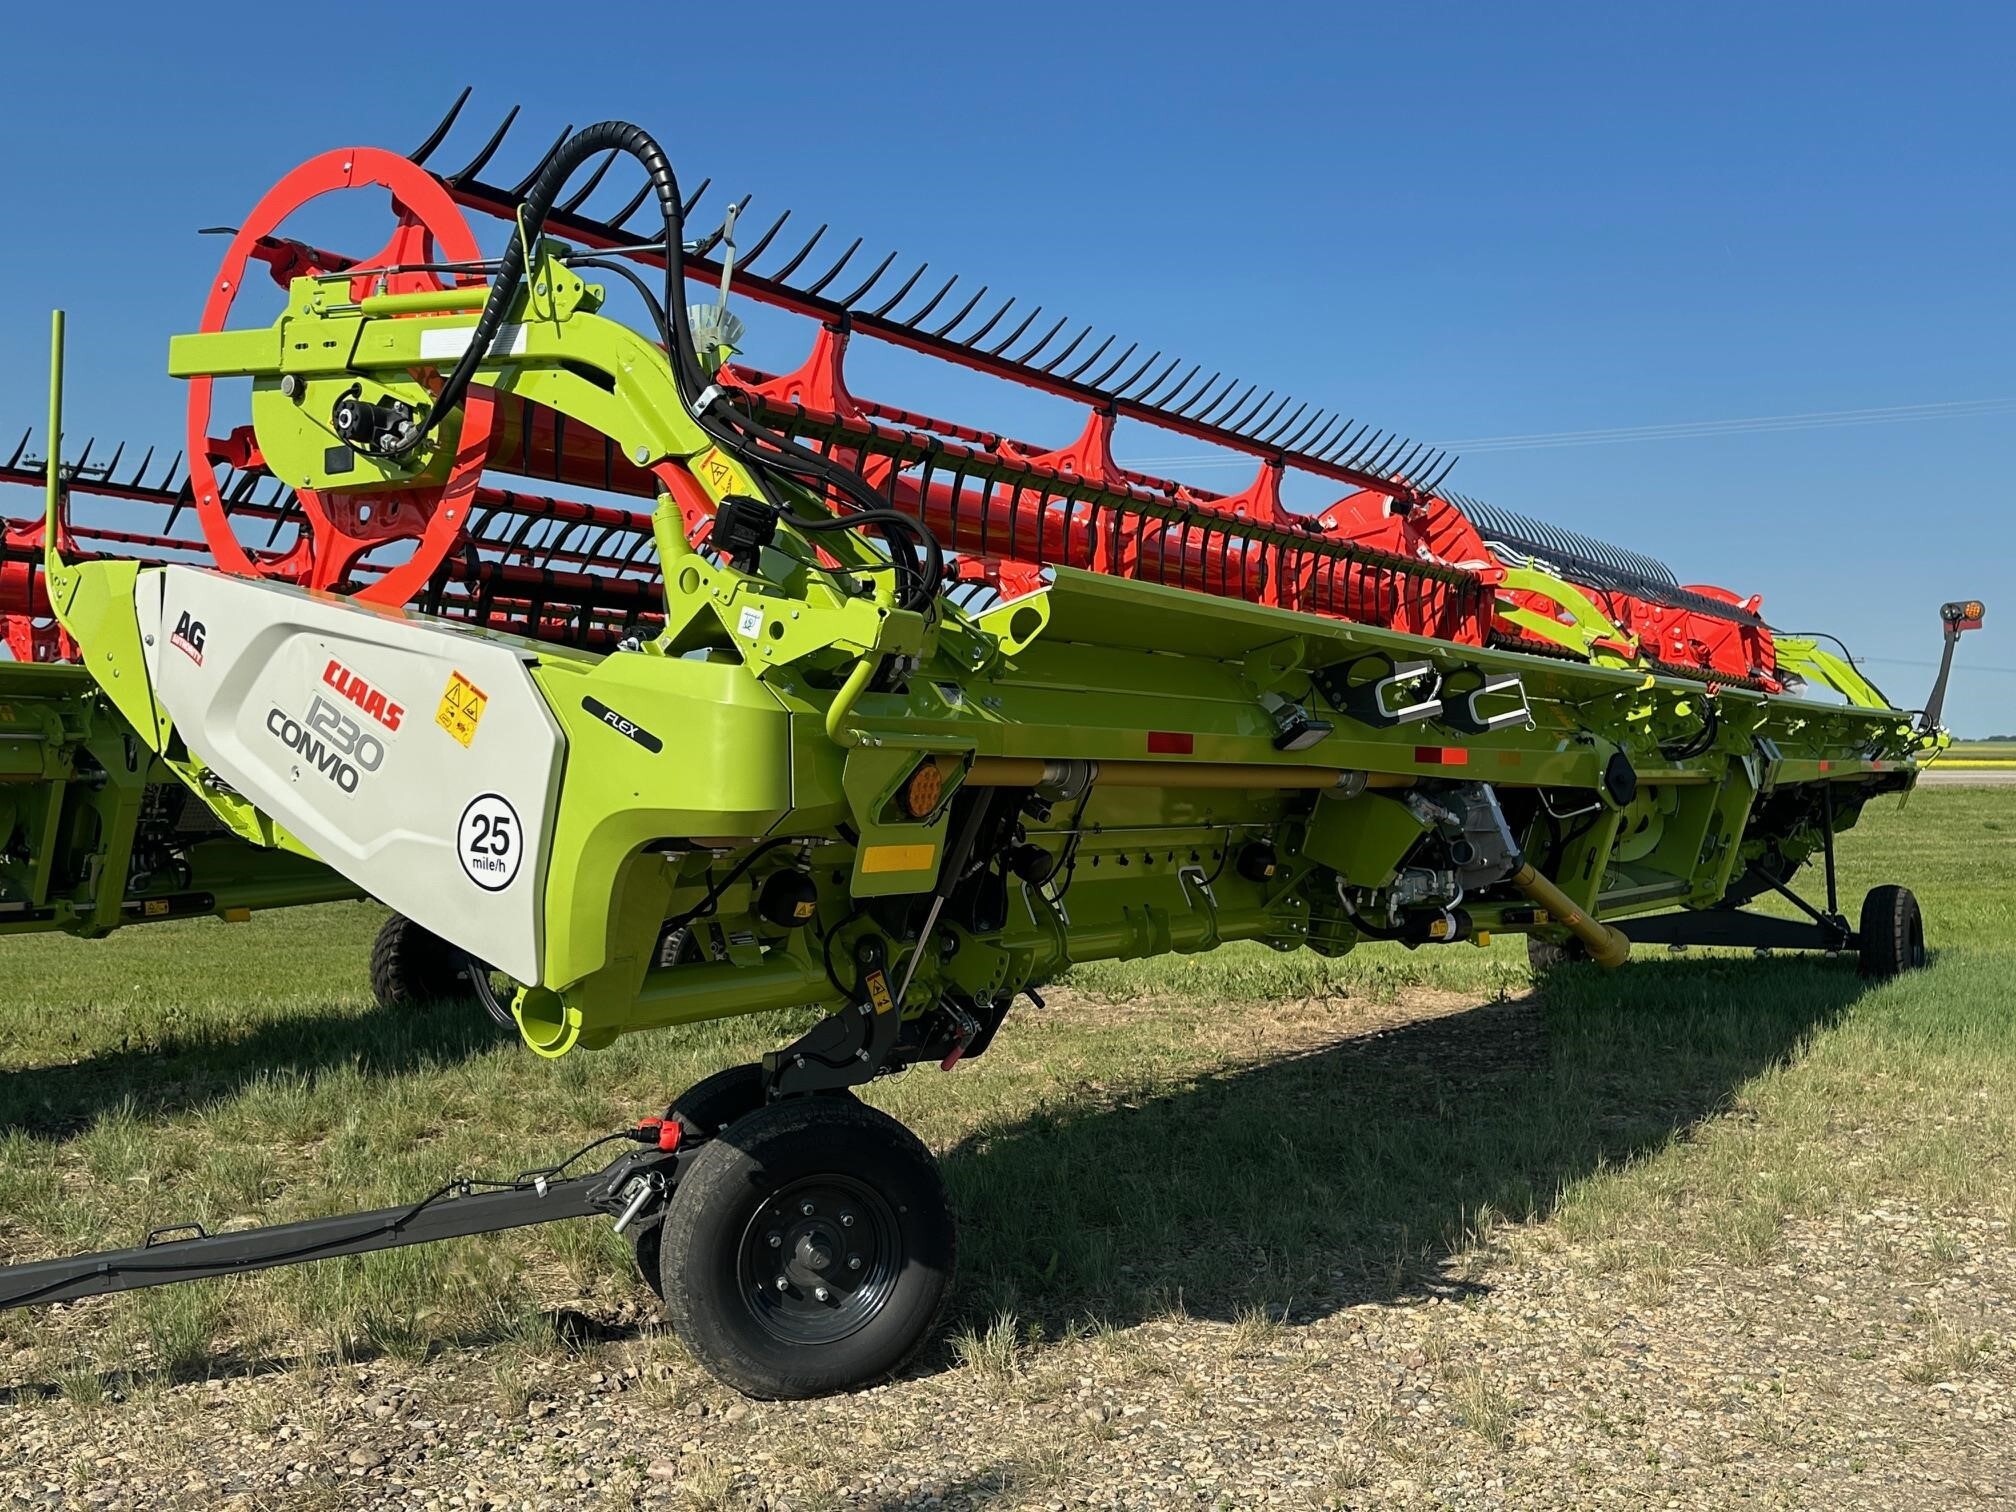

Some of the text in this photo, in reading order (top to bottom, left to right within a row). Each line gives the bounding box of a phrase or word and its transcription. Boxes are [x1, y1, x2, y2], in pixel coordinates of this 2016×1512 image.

[175, 610, 206, 655] AG
[323, 660, 405, 732] CLAAS
[305, 695, 384, 772] 1230
[604, 711, 639, 738] FLEX
[267, 708, 359, 793] CONVIO
[470, 814, 510, 856] 25
[472, 856, 506, 873] mile/h
